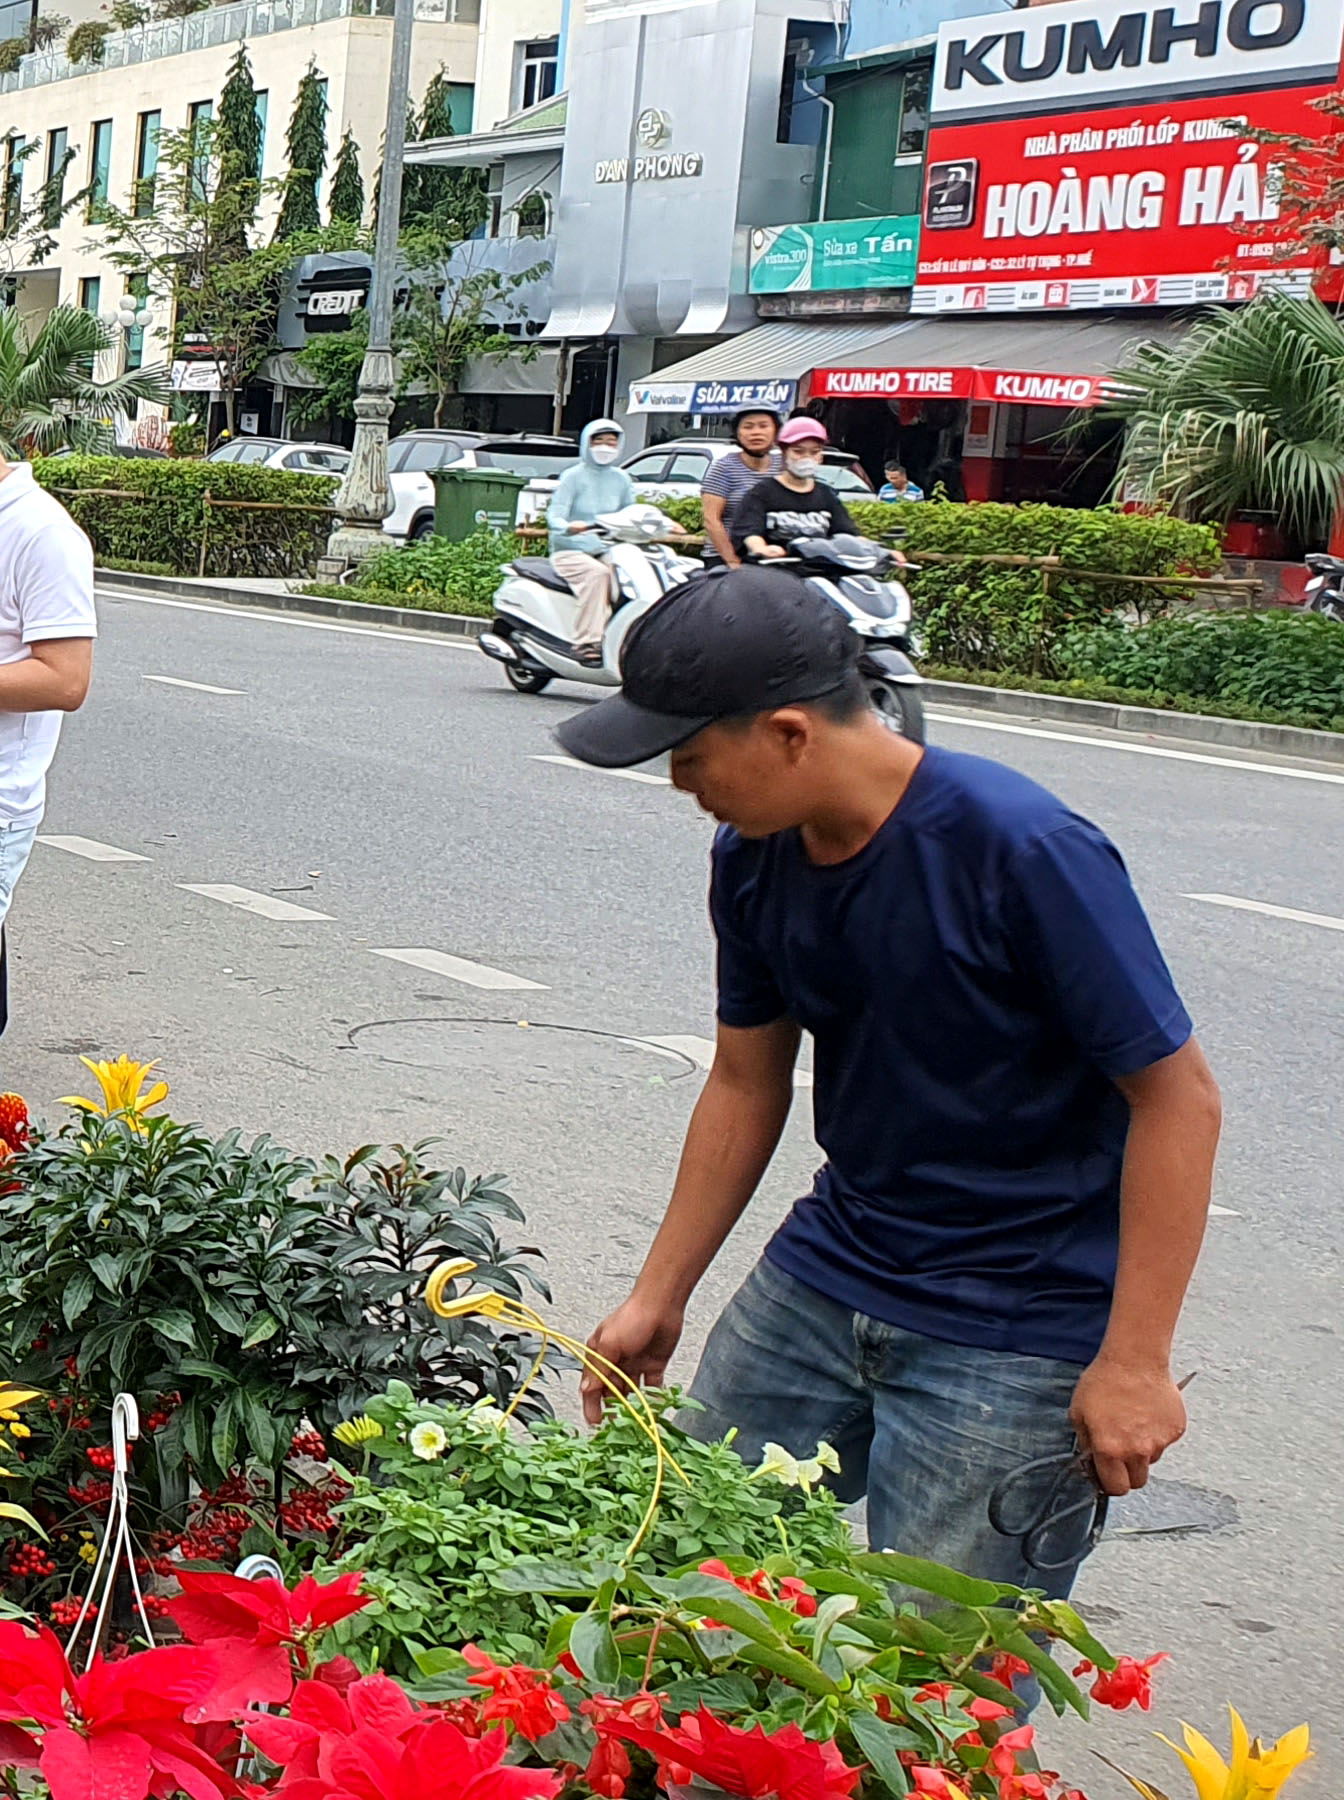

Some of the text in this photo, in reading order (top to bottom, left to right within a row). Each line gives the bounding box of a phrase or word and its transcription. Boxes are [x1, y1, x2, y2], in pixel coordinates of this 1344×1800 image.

[944, 0, 1305, 90] KUMHO
[1024, 132, 1057, 157] NHÀ
[1058, 128, 1103, 153] PHÂN
[1106, 120, 1144, 149] PHỐI
[1147, 116, 1179, 146] LỐP
[633, 153, 703, 181] PHONG
[983, 166, 1166, 239] HOÀNG
[863, 232, 913, 254] Tấn
[307, 289, 365, 316] CREDIT
[696, 380, 790, 404] SỬA XE TẤN
[826, 372, 954, 392] KUMHO TIRE
[994, 375, 1091, 401] KUMHO
